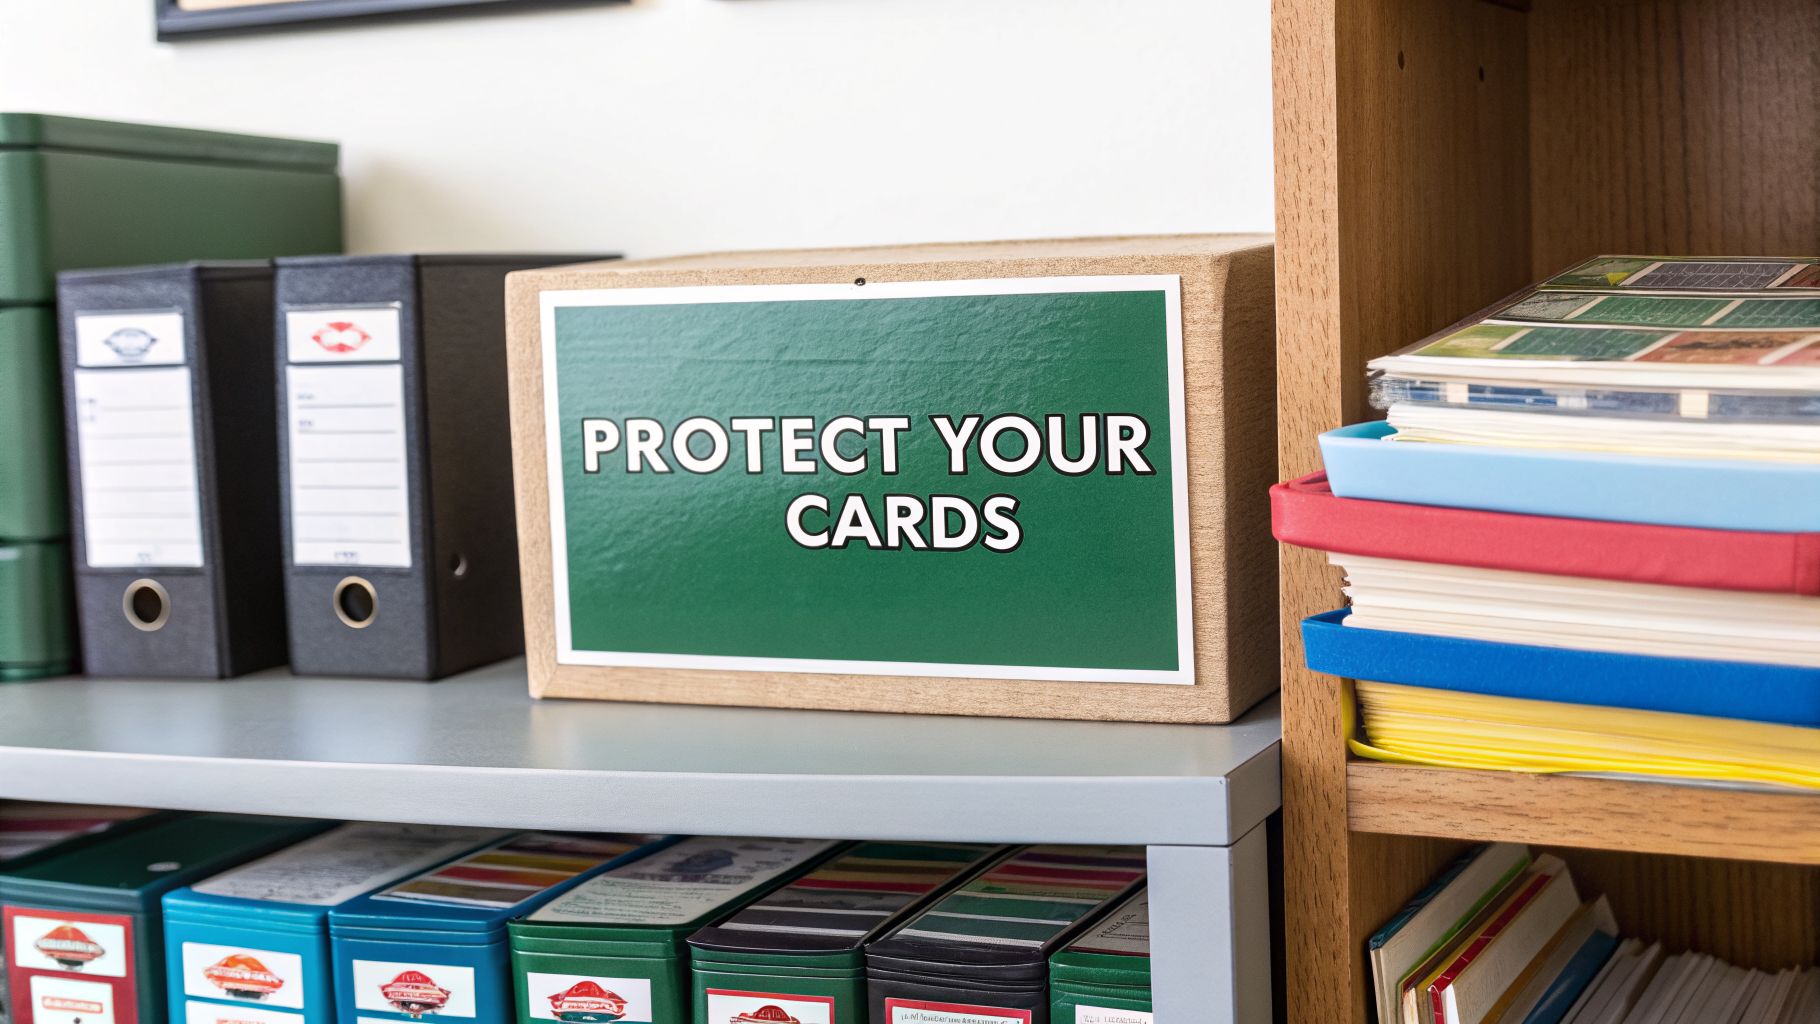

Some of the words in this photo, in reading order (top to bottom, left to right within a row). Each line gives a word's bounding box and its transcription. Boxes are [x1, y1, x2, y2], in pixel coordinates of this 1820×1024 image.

[582, 415, 910, 475] PROTECT
[930, 413, 1155, 475] YOUR
[785, 493, 1022, 552] CARDS
